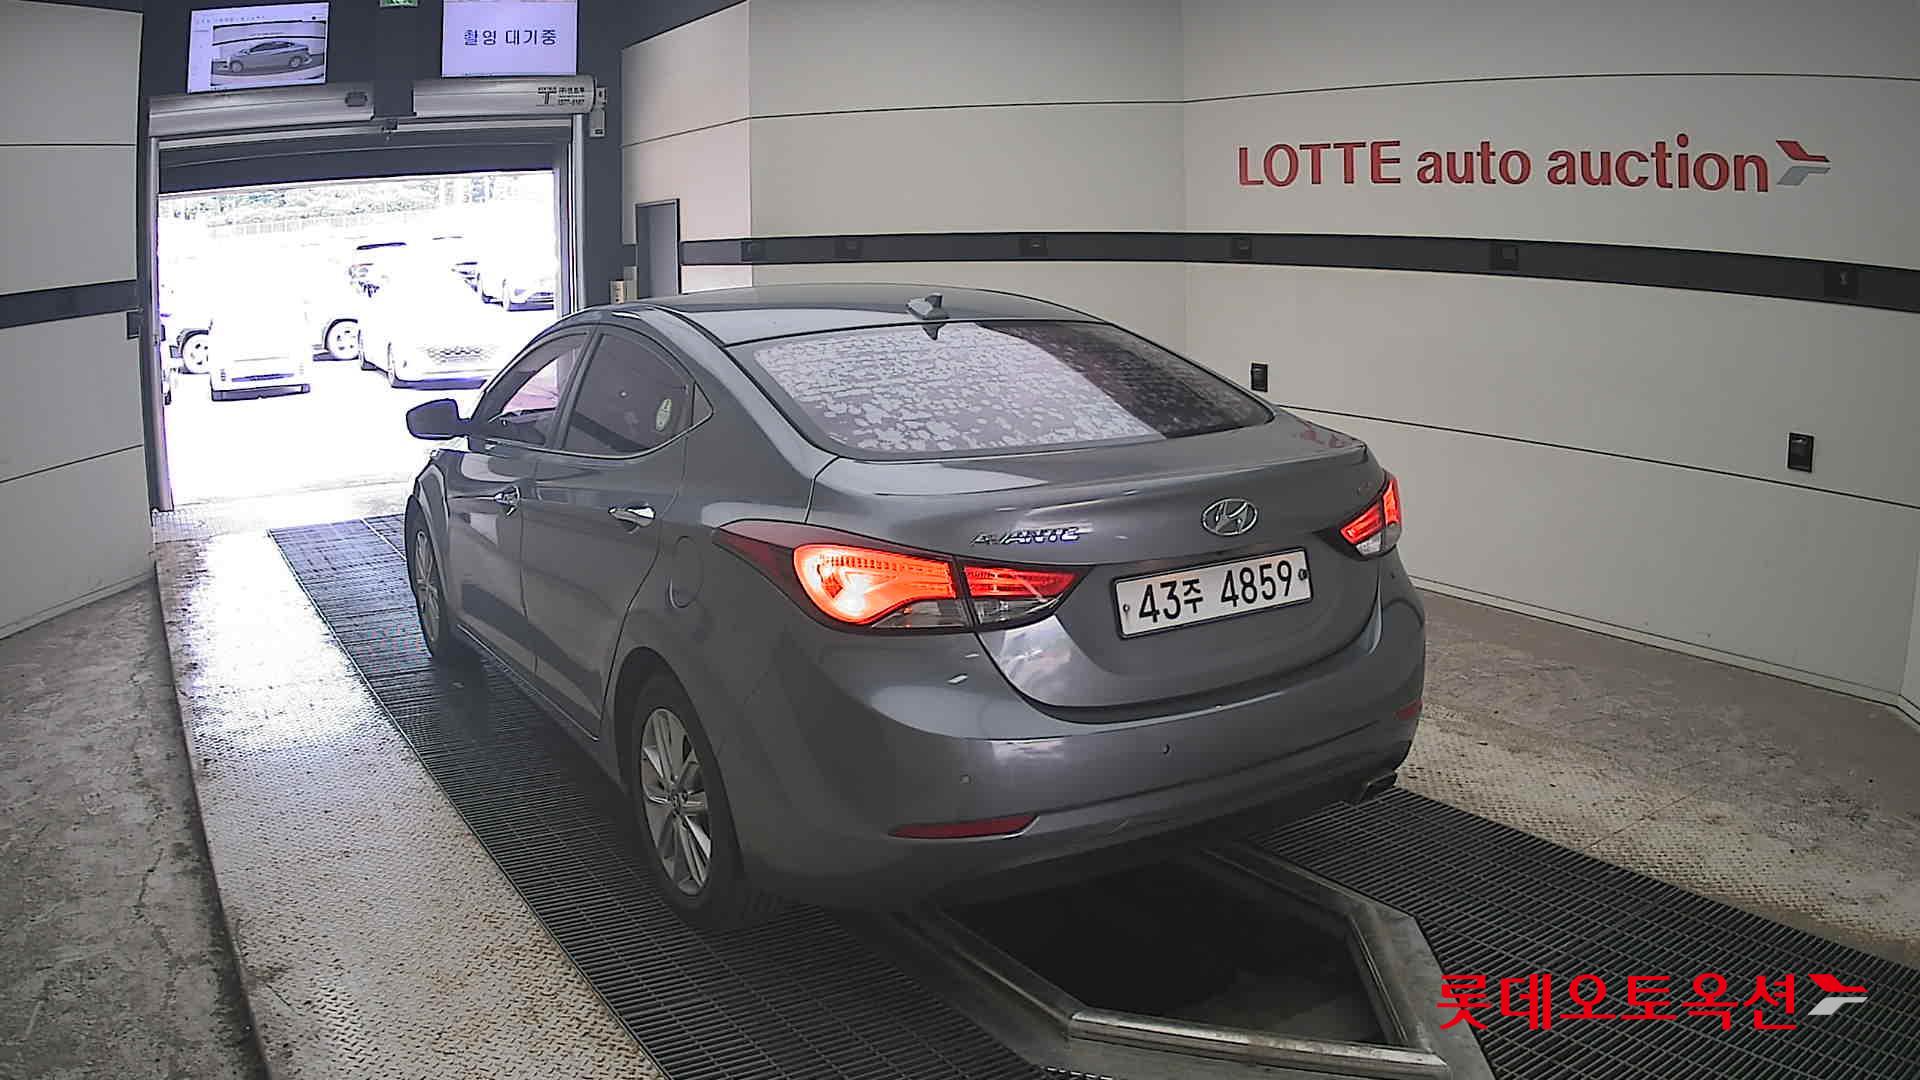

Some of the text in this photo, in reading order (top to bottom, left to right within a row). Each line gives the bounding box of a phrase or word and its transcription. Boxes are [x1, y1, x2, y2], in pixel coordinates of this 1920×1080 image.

[504, 28, 557, 46] 대기중
[1239, 133, 1769, 192] LOTTE auto auction
[1138, 559, 1293, 623] 43주 4859
